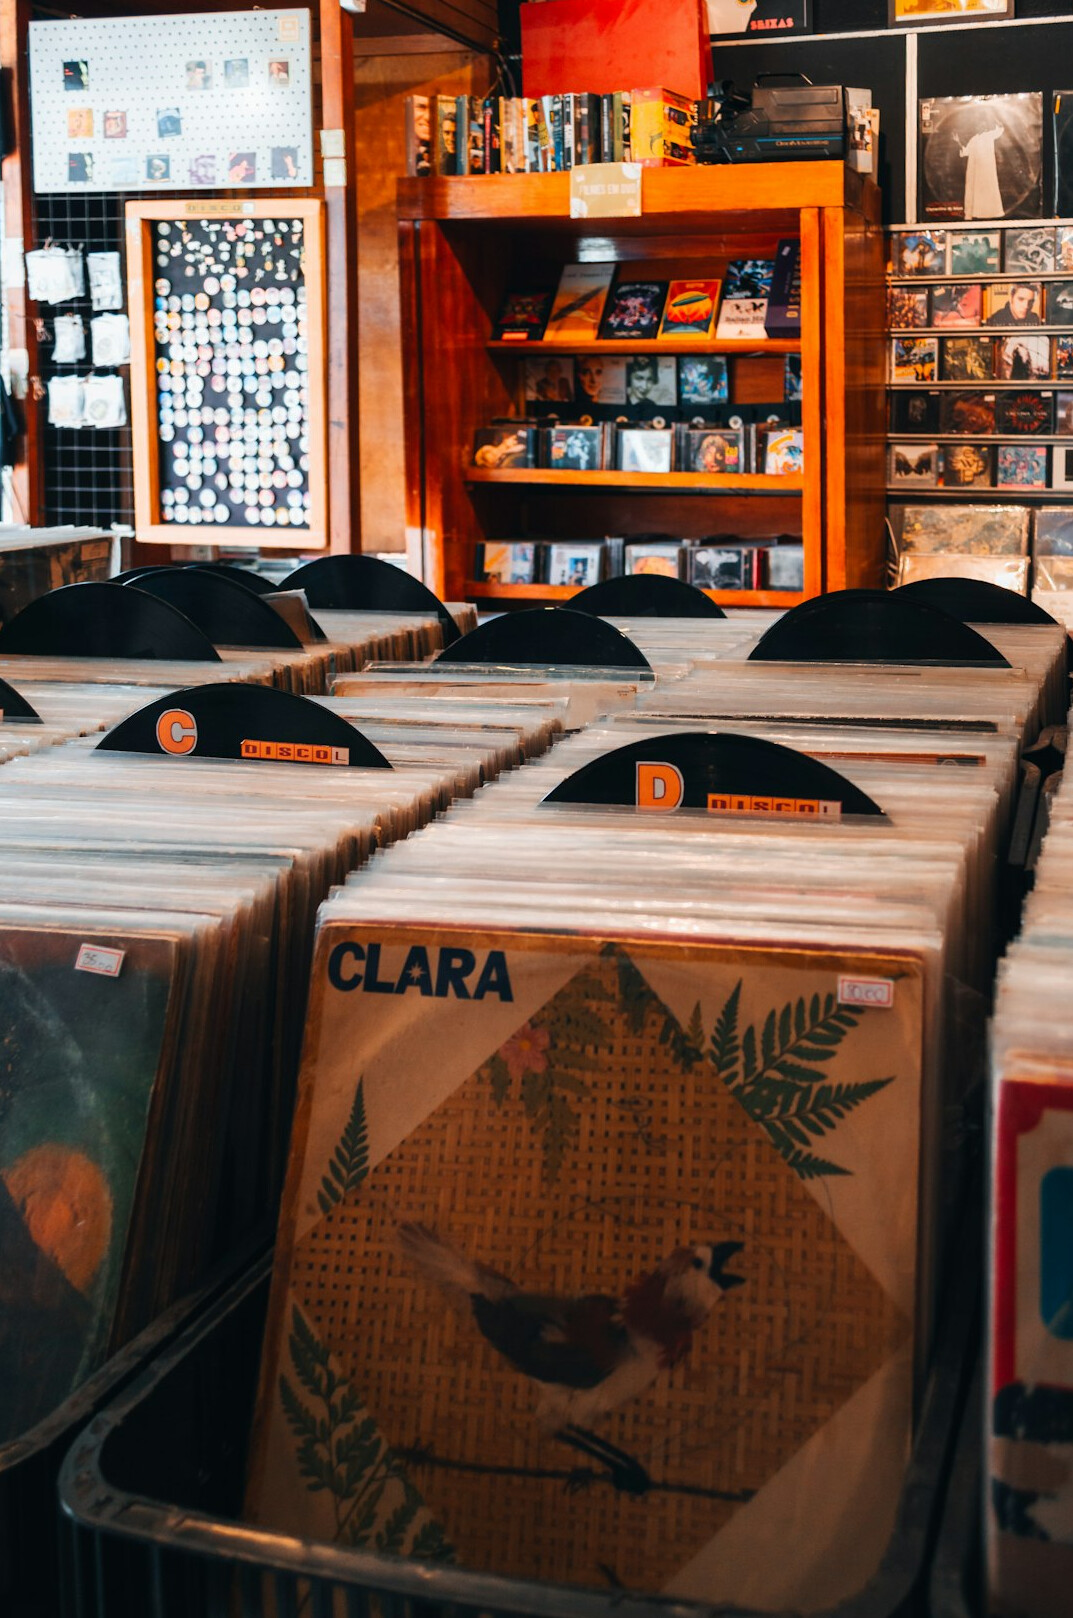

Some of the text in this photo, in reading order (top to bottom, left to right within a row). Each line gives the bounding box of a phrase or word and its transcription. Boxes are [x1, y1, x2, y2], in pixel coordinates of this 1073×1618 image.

[156, 708, 197, 756] C
[636, 761, 684, 812] D
[328, 941, 514, 1002] CLARA
